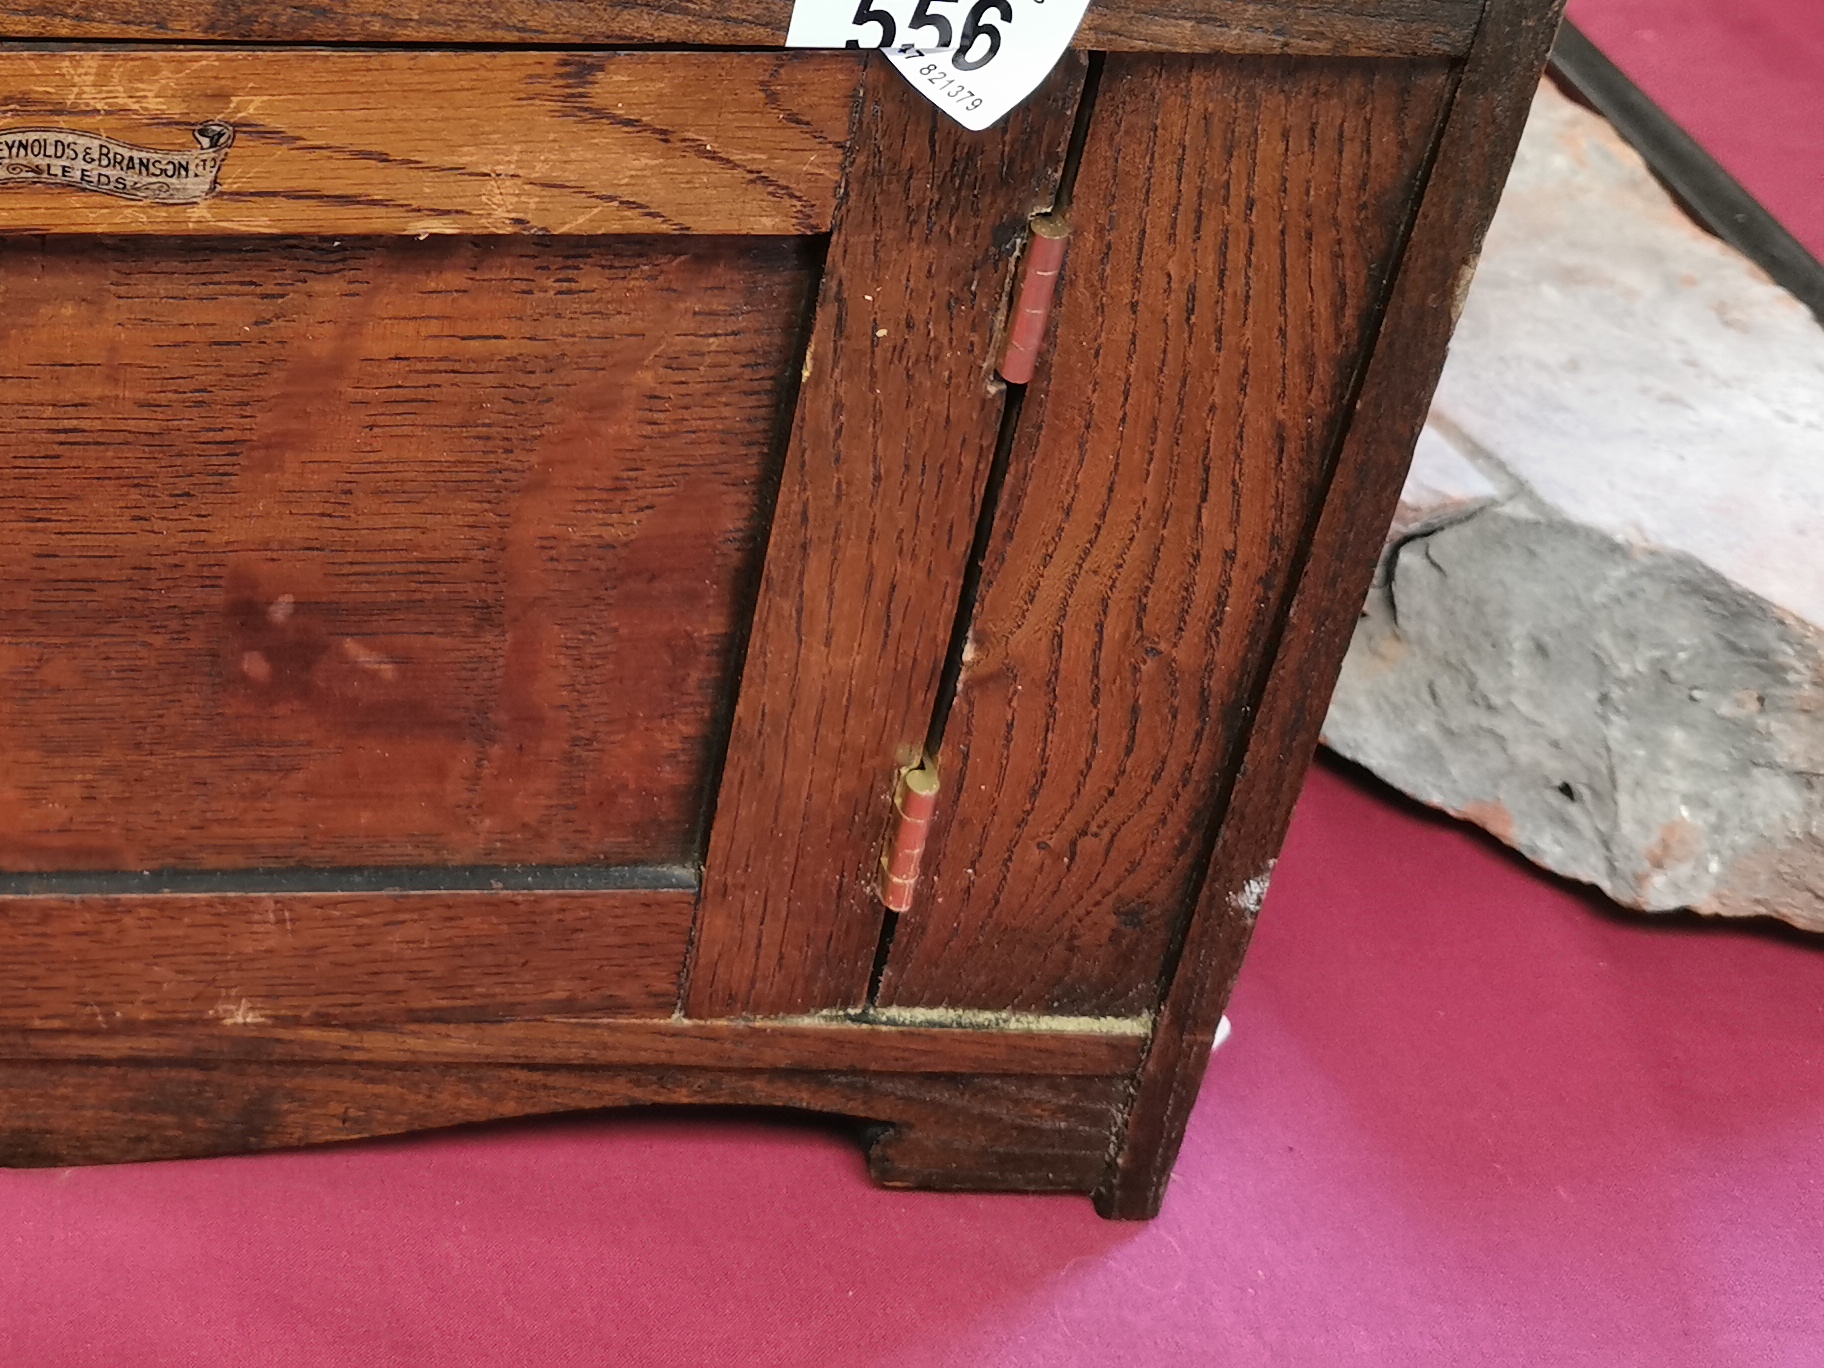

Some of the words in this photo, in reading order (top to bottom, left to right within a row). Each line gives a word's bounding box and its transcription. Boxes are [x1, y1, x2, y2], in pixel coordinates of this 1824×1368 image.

[919, 63, 983, 112] 821379
[46, 163, 127, 191] LEEDS
[82, 145, 96, 165] &
[98, 144, 189, 178] BRANSON
